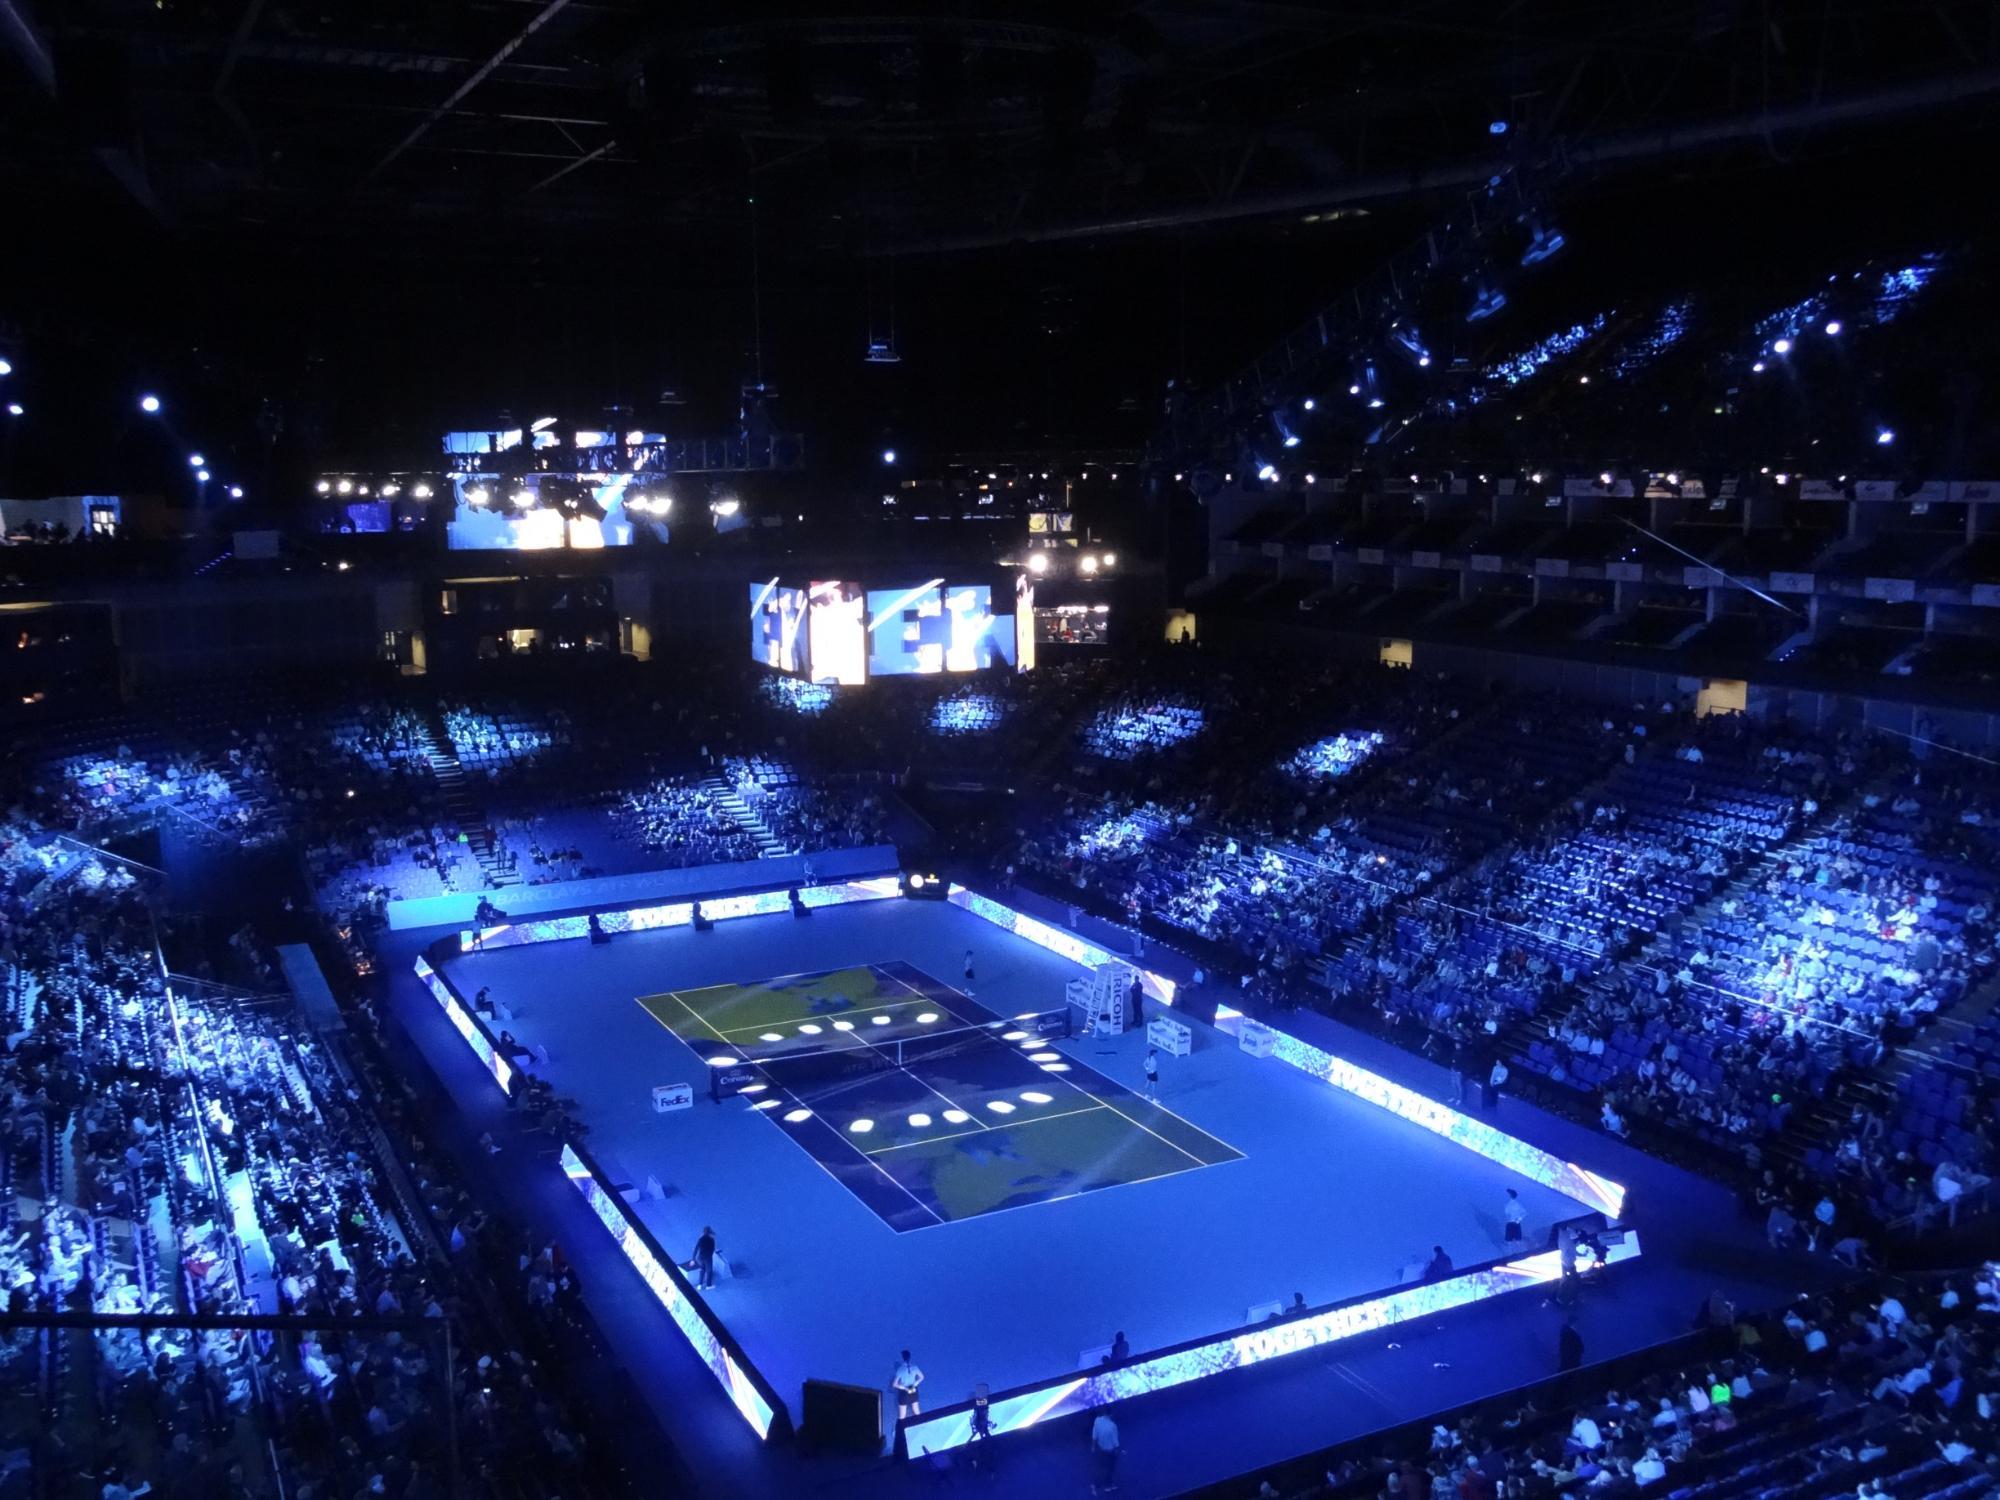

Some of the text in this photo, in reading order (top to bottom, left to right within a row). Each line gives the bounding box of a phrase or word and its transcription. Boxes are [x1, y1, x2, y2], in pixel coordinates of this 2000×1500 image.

[496, 880, 592, 904] BARCLAYS
[1113, 977, 1122, 1026] RICOH
[661, 1095, 690, 1107] FedEx
[1231, 1300, 1387, 1365] TOGETHER
